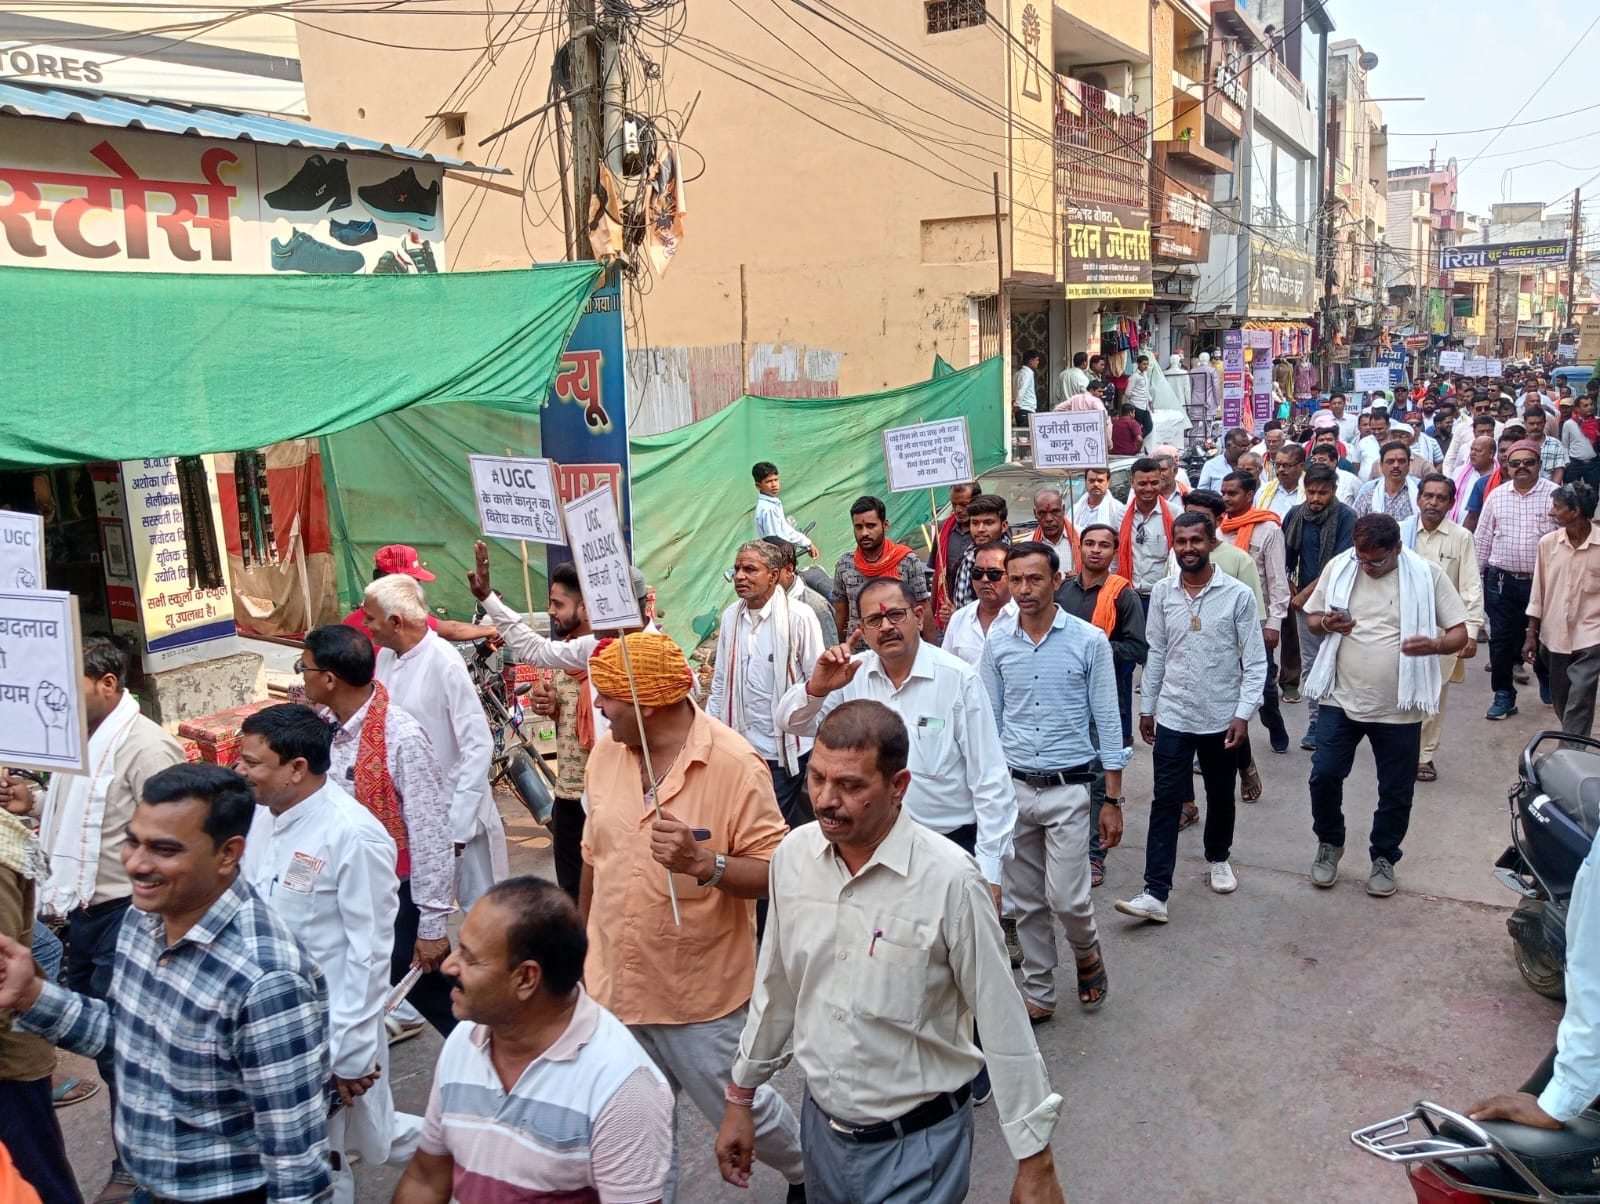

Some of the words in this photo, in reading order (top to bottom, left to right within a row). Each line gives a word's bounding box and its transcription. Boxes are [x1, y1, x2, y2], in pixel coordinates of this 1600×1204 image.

[1444, 247, 1486, 268] रिया
[1037, 420, 1070, 439] यूजीसी
[1071, 421, 1099, 433] काला
[1049, 439, 1074, 452] कानून
[1045, 453, 1068, 463] वापस
[1069, 450, 1081, 462] लो
[499, 467, 536, 490] UGC
[481, 489, 492, 505] के
[492, 491, 513, 506] काले
[538, 497, 551, 510] का
[486, 508, 510, 525] विरोध
[510, 513, 533, 527] करता
[584, 507, 602, 533] UGC
[4, 528, 32, 547] UGC
[148, 530, 176, 545] नवोदय
[581, 532, 619, 564] ROLLBACK
[147, 592, 167, 609] सभी
[176, 606, 205, 624] उपलब्ध
[0, 617, 58, 639] बदलाव
